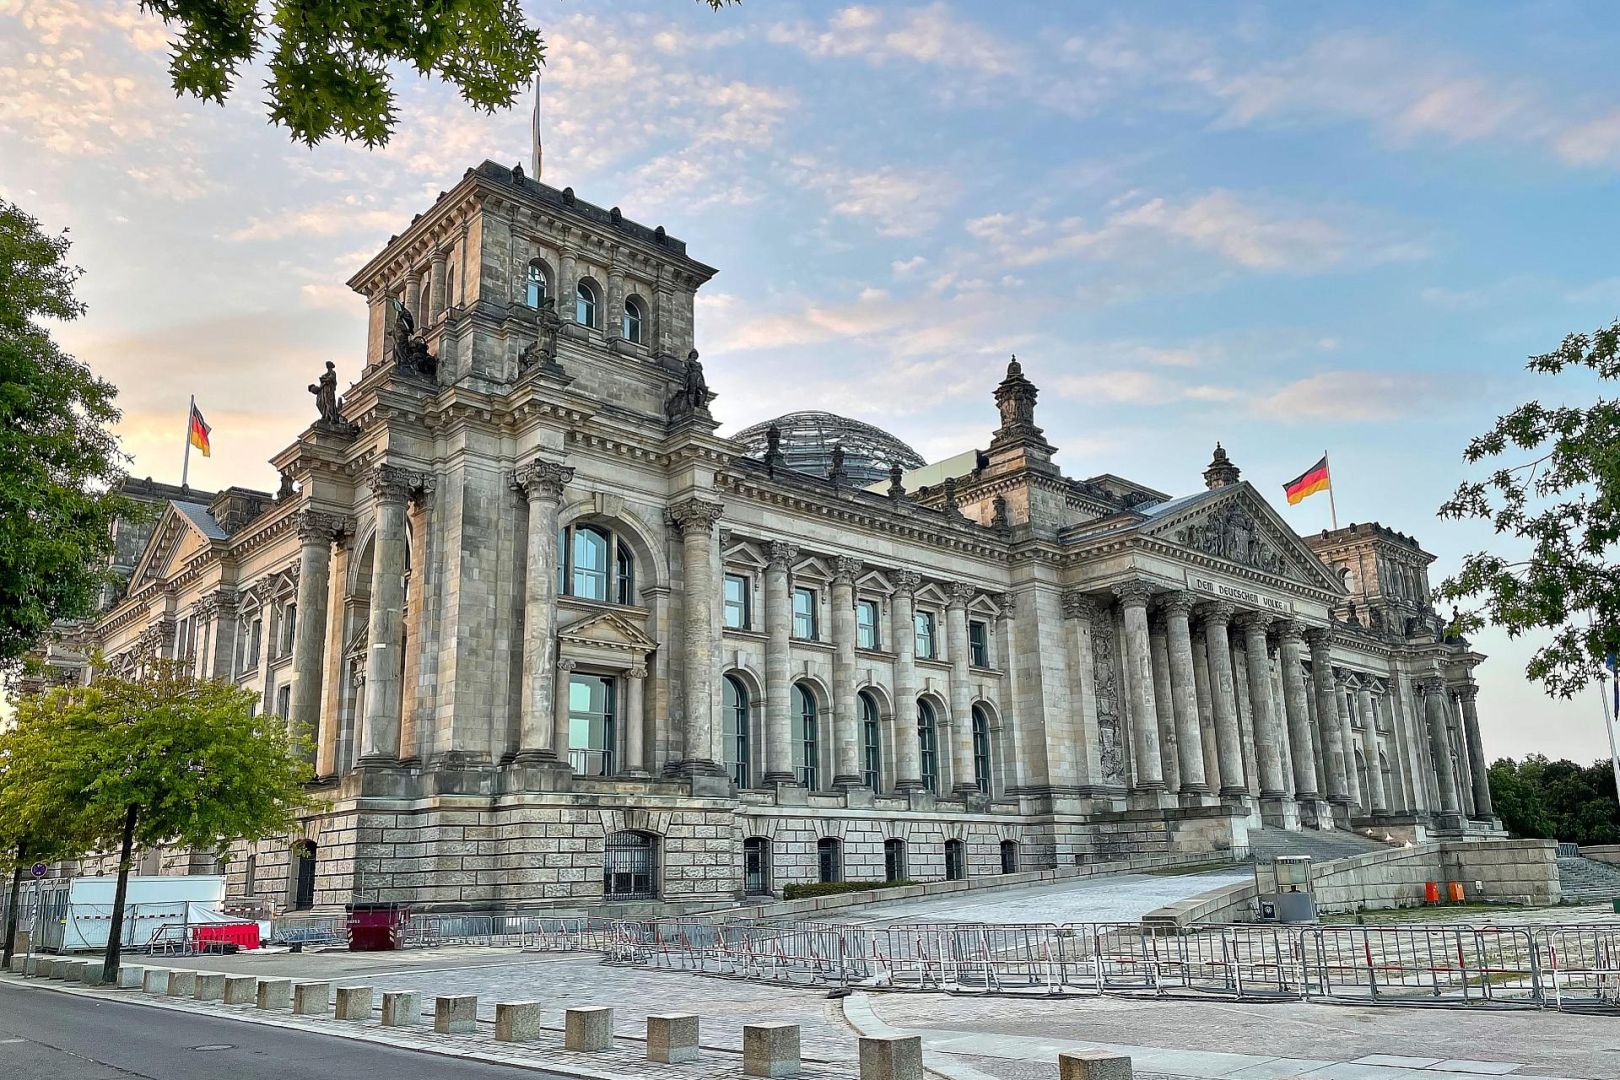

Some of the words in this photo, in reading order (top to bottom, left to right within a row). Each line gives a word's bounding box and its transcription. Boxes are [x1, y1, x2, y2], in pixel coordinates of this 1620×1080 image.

[1197, 579, 1213, 591] DEM
[1219, 585, 1258, 604] DEUTSCHEN
[1263, 597, 1282, 609] VOLKE
